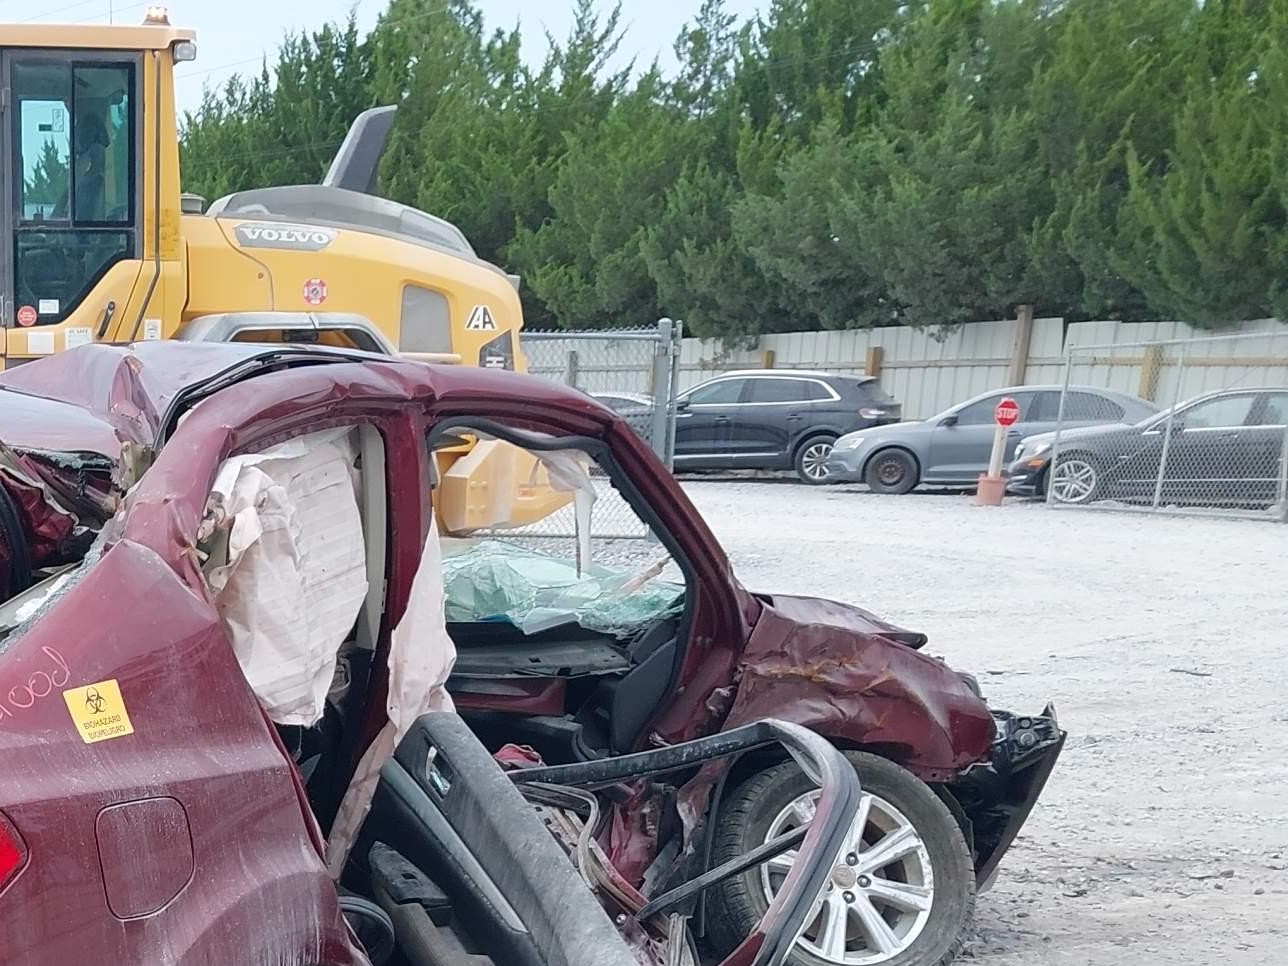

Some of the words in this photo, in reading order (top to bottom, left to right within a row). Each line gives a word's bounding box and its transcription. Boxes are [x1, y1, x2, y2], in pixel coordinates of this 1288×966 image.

[240, 227, 328, 243] VOLVO
[997, 407, 1018, 418] STOP
[83, 714, 122, 730] BIOHAZARD
